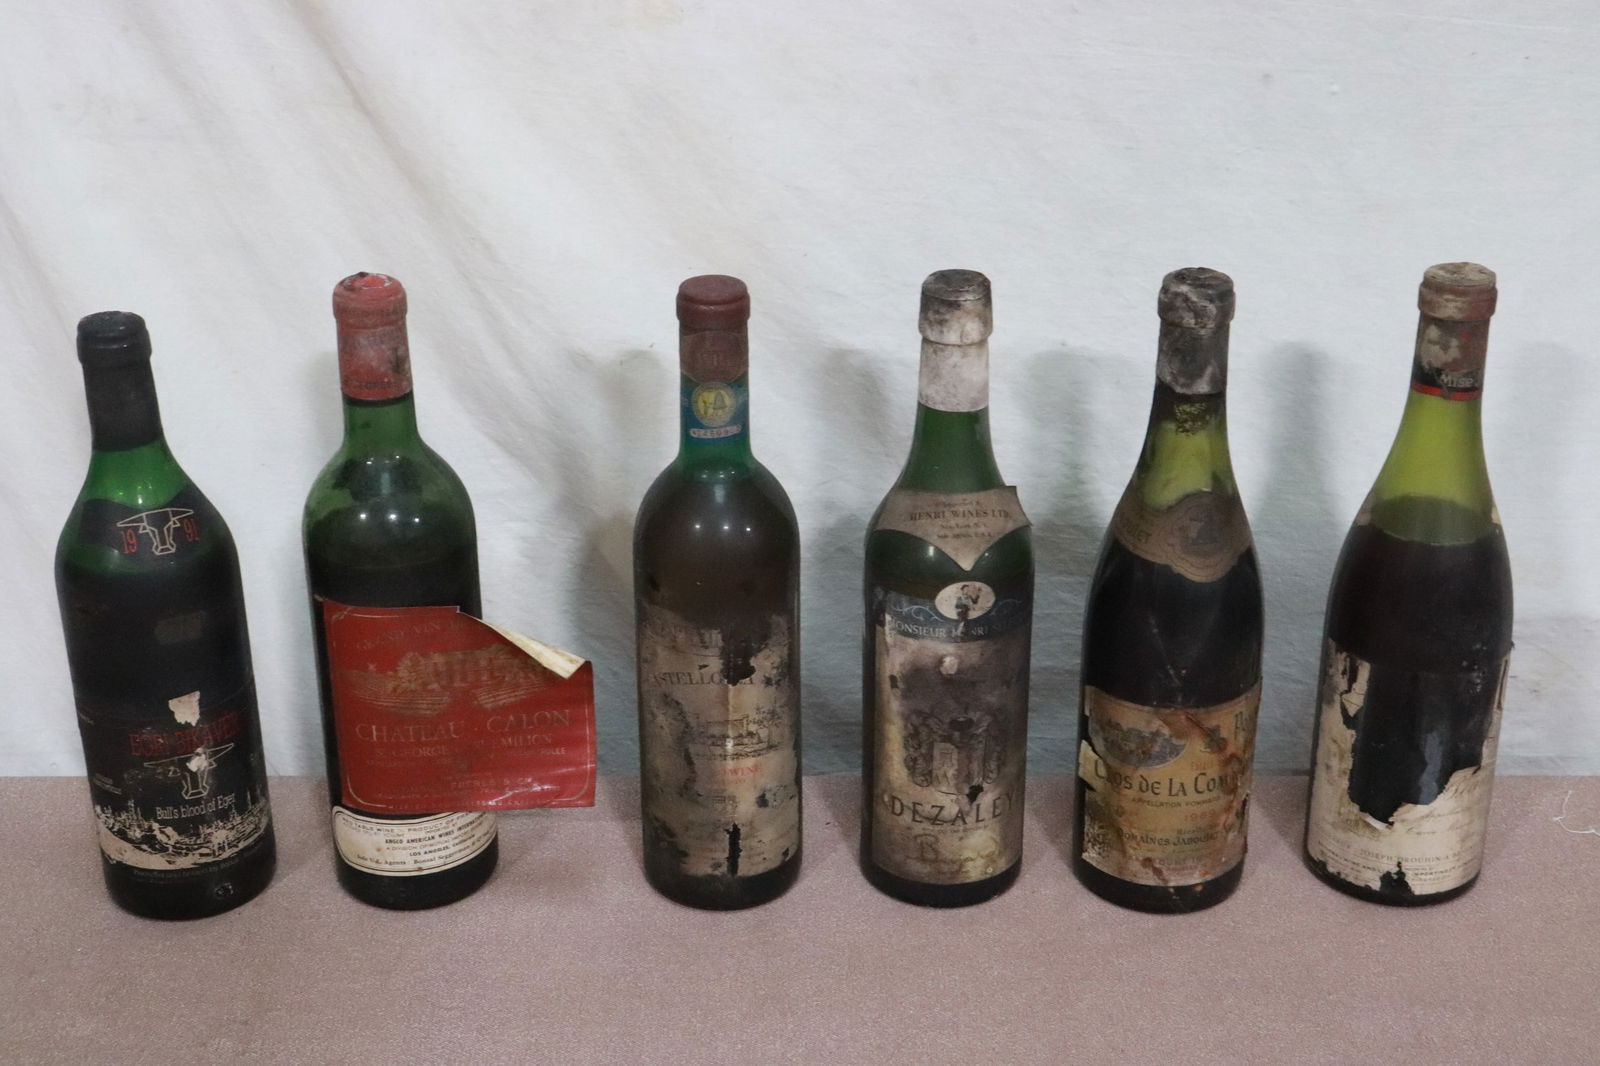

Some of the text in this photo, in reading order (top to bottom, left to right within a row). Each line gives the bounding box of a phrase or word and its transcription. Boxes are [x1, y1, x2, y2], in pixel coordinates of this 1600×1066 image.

[909, 510, 946, 521] HENRI
[950, 509, 988, 519] WINES
[120, 528, 138, 554] 19
[647, 671, 722, 687] ASTELLO
[486, 710, 571, 734] CALON
[180, 800, 206, 818] blood
[207, 797, 216, 812] of
[890, 792, 1016, 826] DEZALEY
[1131, 797, 1182, 808] APPELLATION
[407, 822, 443, 832] PRODUCT
[406, 835, 435, 844] AMERICAN
[438, 829, 455, 838] WINES
[1359, 848, 1395, 861] JOSEPH
[1397, 855, 1441, 864] DROUHIN
